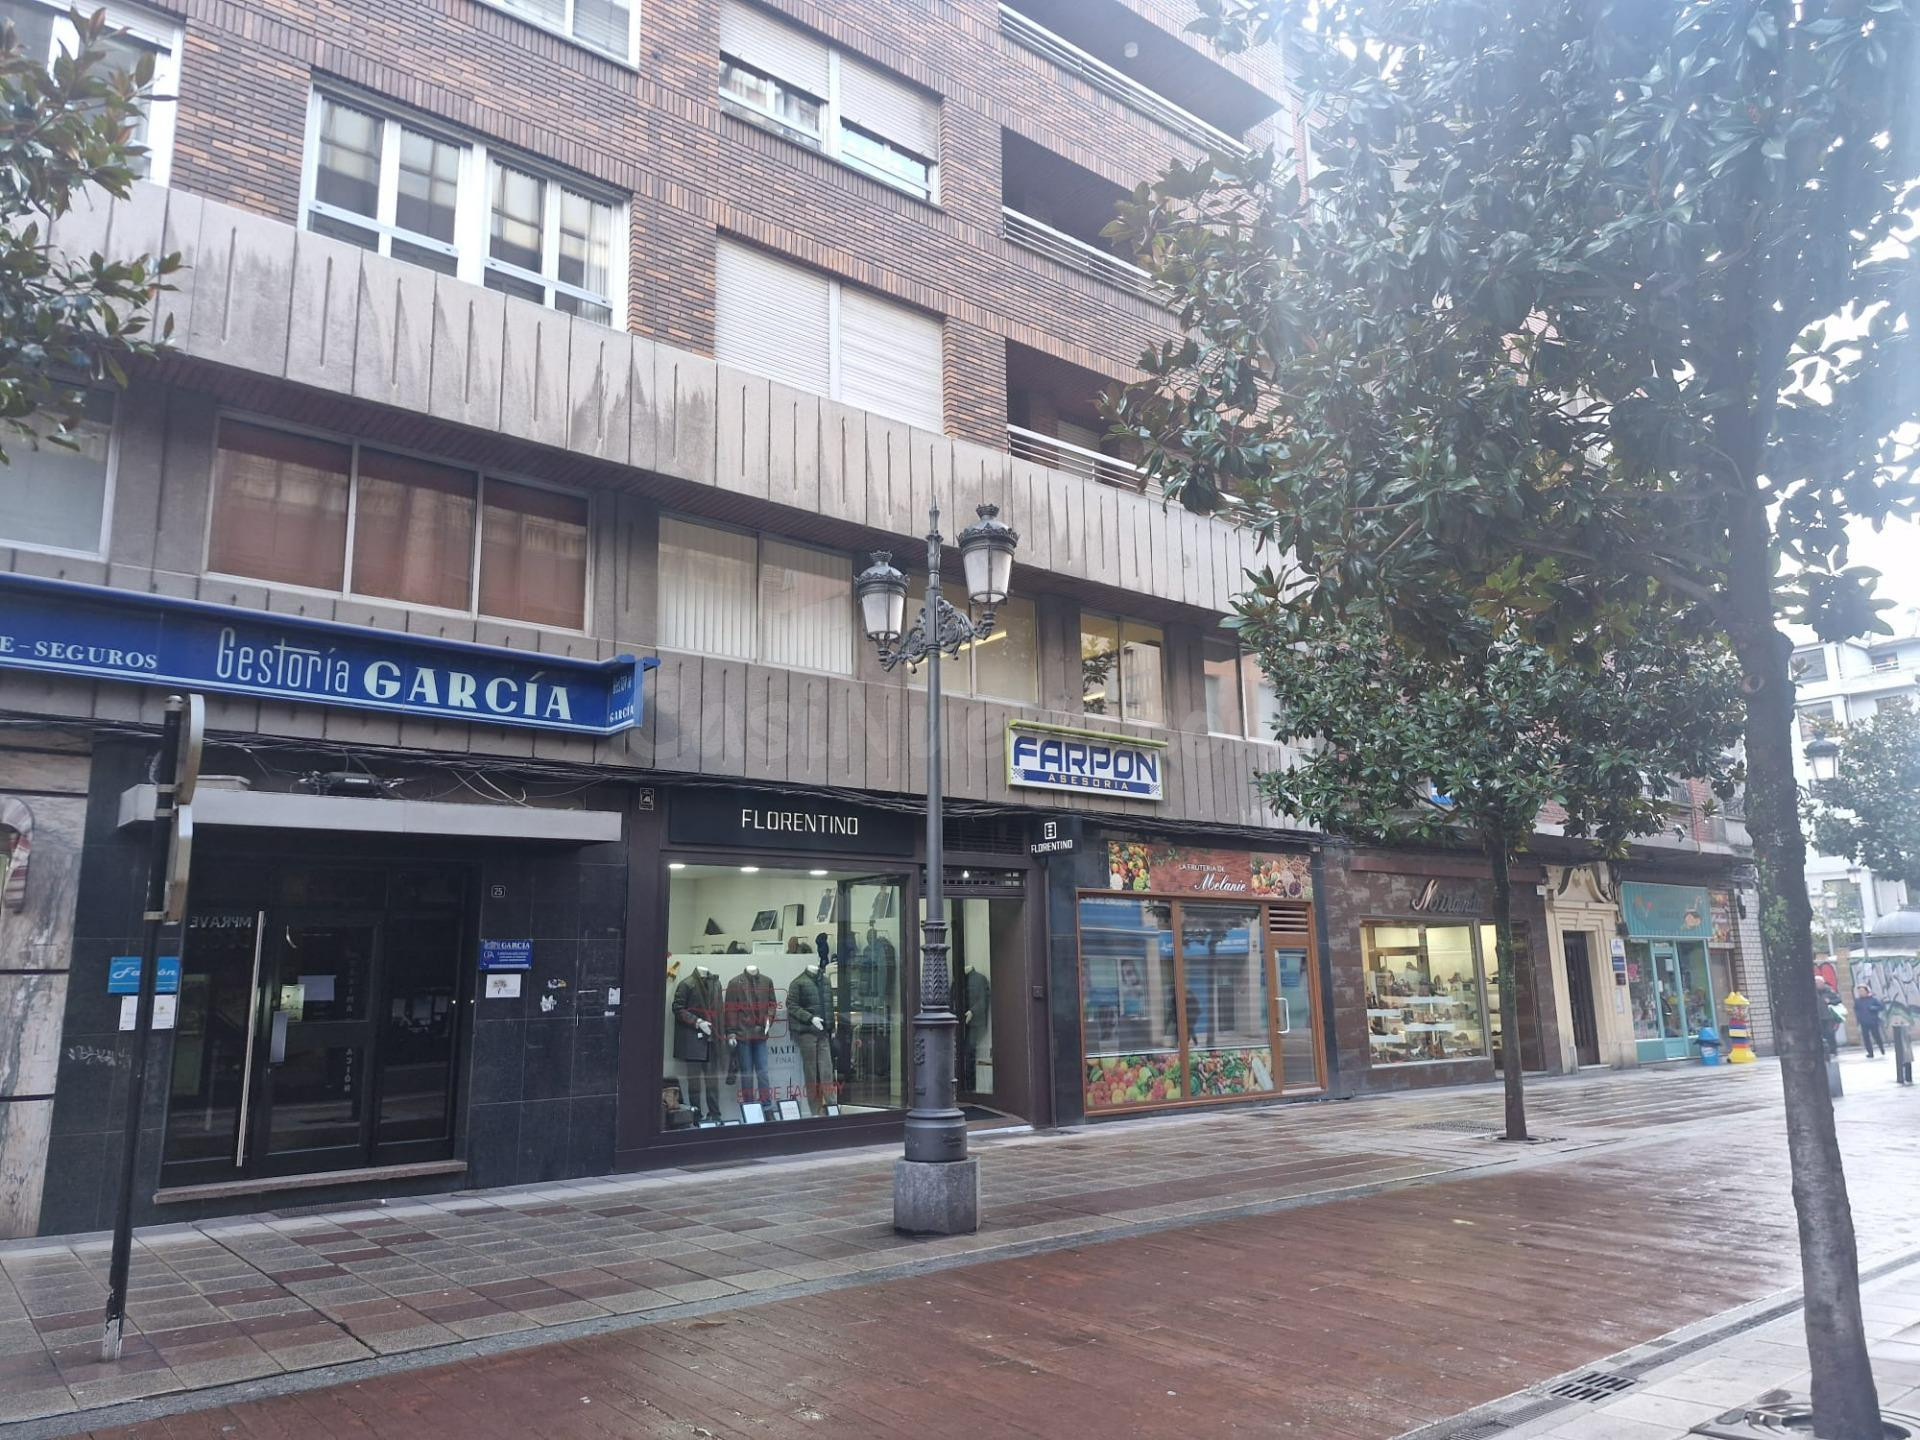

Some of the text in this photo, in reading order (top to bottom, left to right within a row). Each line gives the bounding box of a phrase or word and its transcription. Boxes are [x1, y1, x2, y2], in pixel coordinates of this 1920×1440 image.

[216, 627, 572, 721] Gestoría GARCÍA
[1014, 735, 1157, 783] FARPON
[1048, 773, 1129, 791] ASESORIA
[742, 808, 858, 835] FLORENTINO
[1031, 839, 1073, 853] FLORENTINO
[1194, 873, 1247, 892] Melanie
